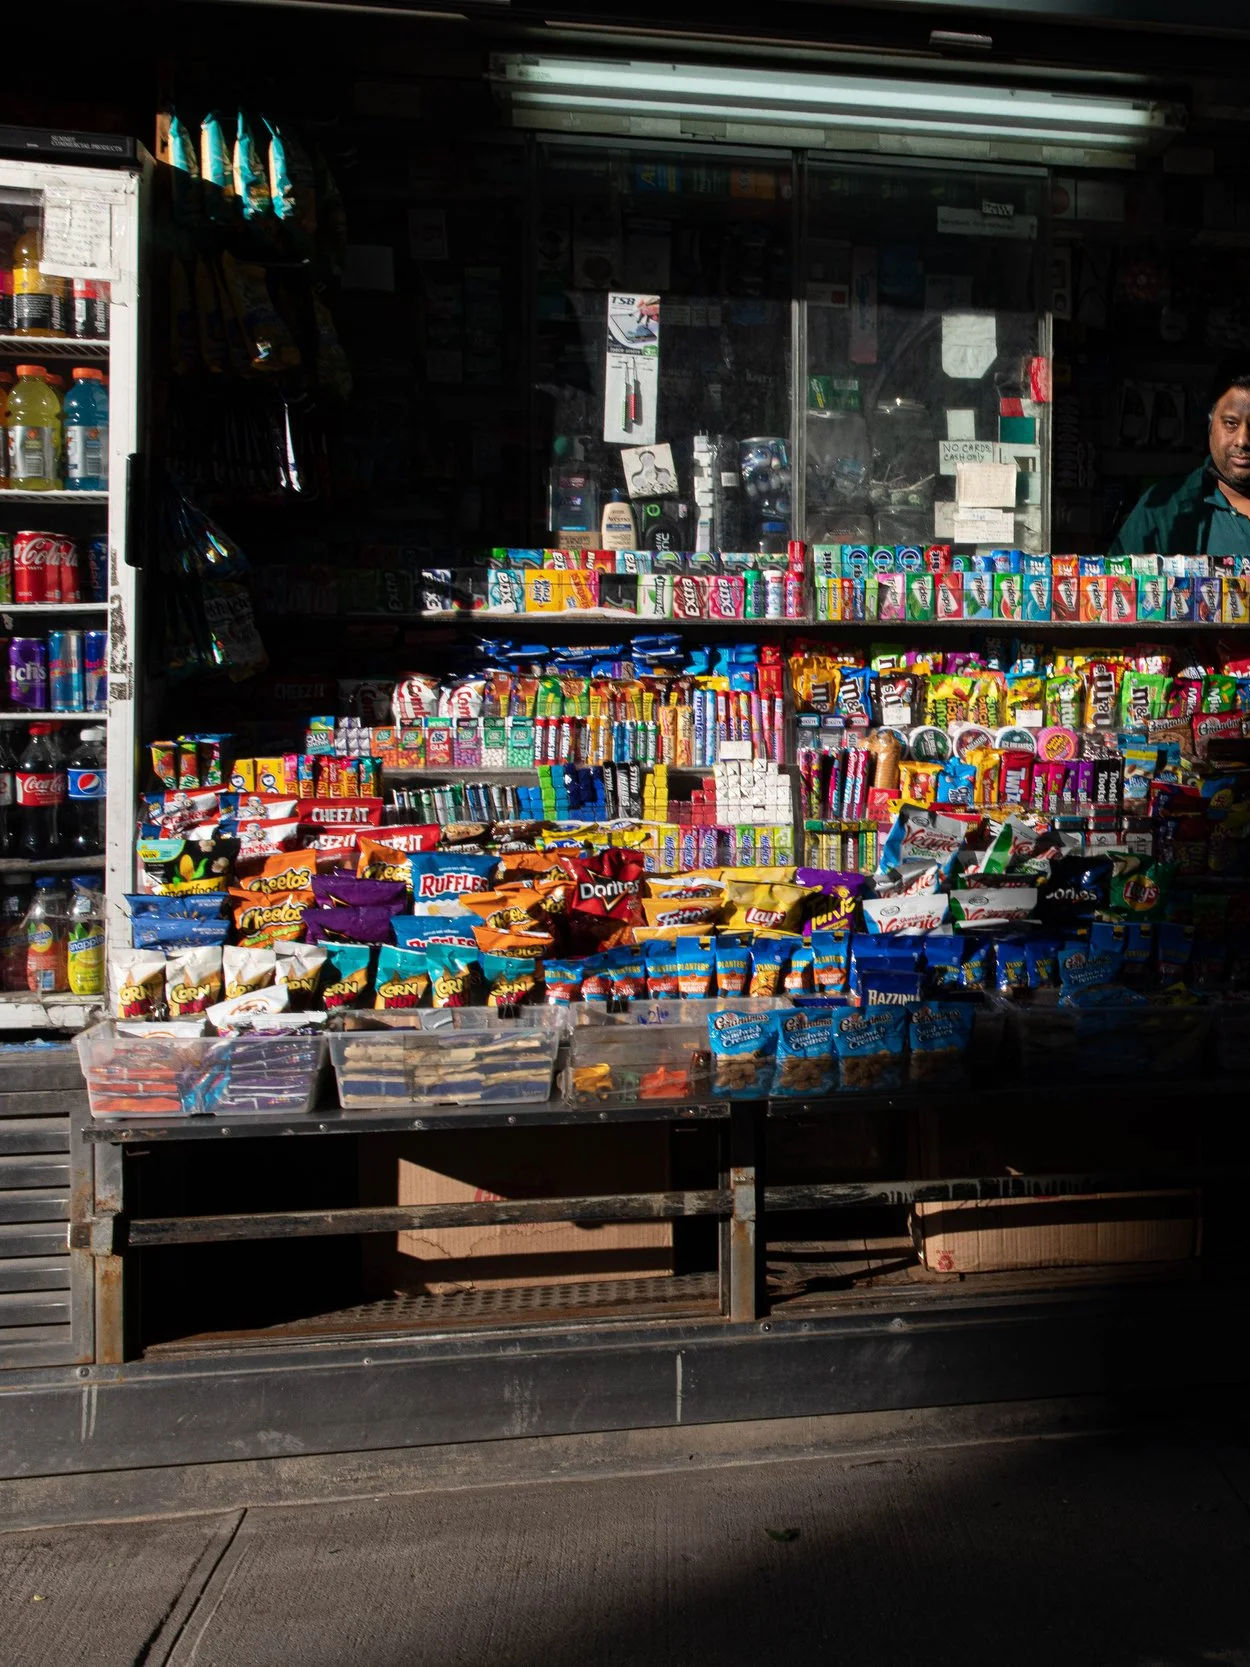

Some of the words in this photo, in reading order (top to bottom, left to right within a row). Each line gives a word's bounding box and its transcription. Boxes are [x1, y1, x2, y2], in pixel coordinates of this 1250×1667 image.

[943, 442, 959, 452] NO
[962, 443, 991, 452] CARDS
[9, 663, 46, 681] lch's
[312, 808, 352, 822] CHEEZ
[356, 808, 369, 822] IT
[903, 825, 961, 851] Veggie
[249, 869, 311, 894] Cheetos
[420, 873, 489, 897] RUFFLES
[580, 880, 640, 900] Doritos
[678, 963, 710, 971] PLANTERS
[171, 982, 211, 1004] CORN
[379, 982, 418, 998] CORN
[720, 1027, 761, 1041] Sandwich
[722, 1033, 761, 1049] Cremes
